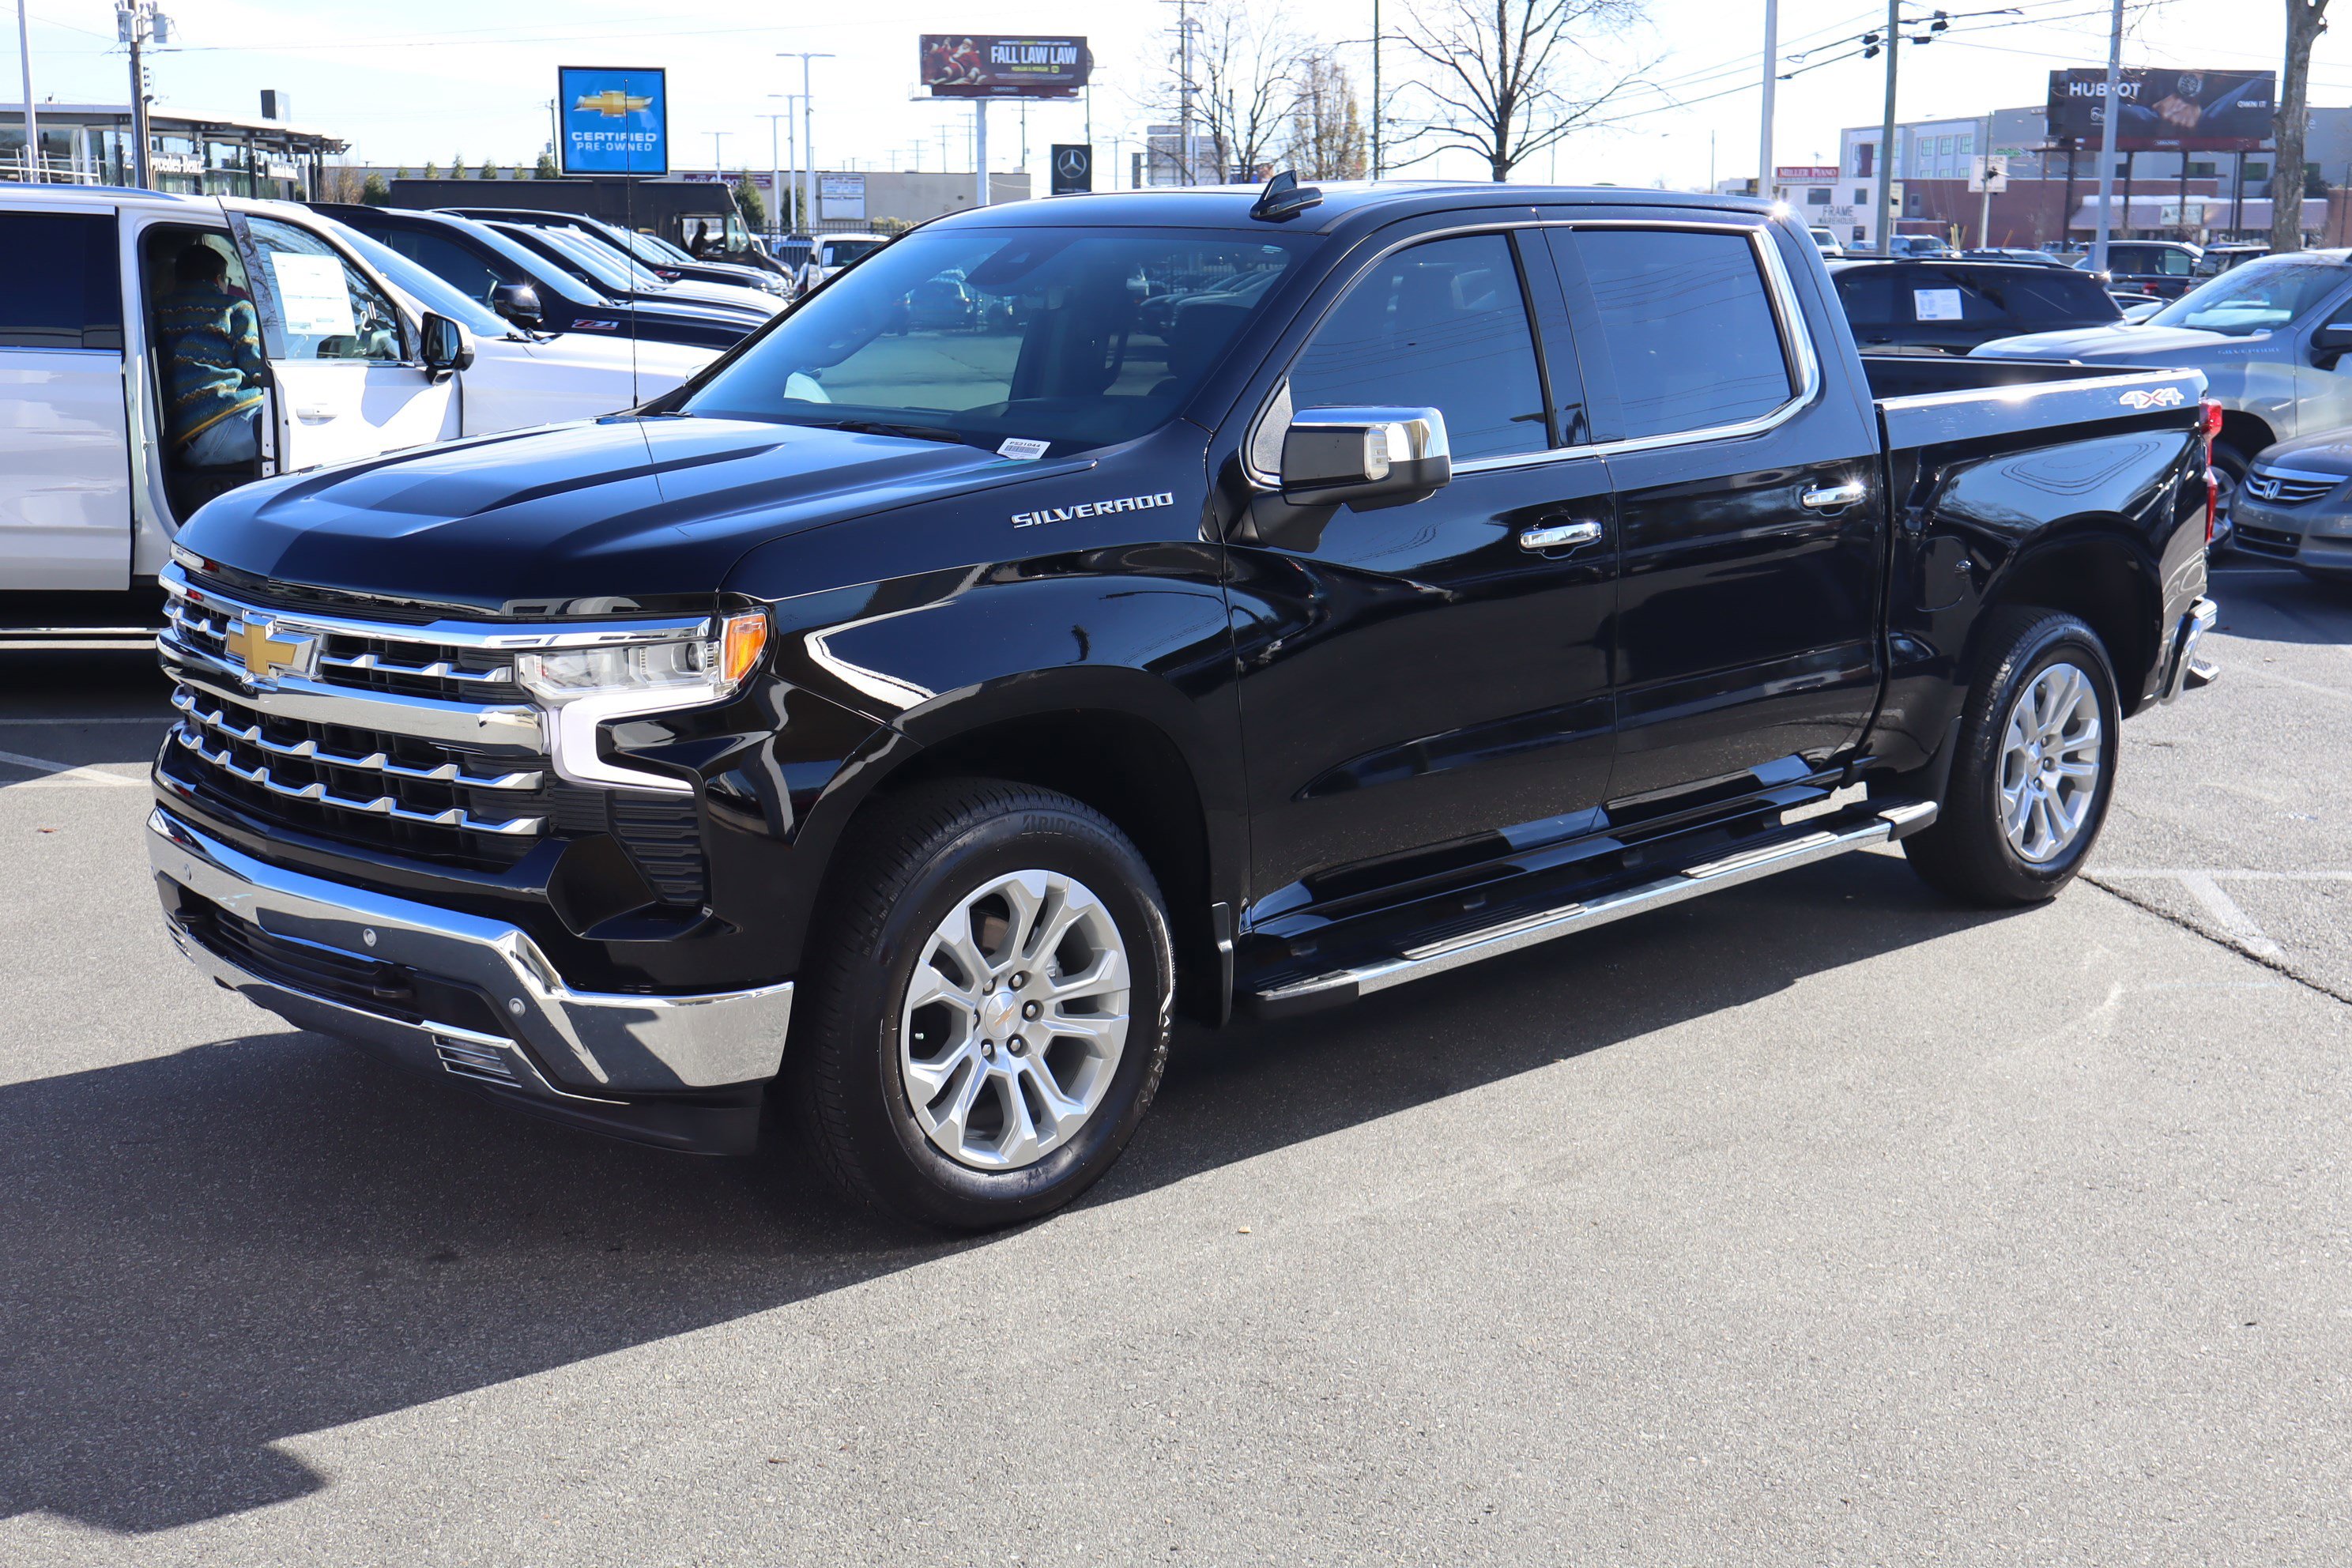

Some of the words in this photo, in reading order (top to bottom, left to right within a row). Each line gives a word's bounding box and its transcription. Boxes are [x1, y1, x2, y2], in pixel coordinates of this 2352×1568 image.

[990, 46, 1019, 64] FALL
[1021, 47, 1048, 64] LAW
[1050, 47, 1077, 65] LAW
[2069, 81, 2142, 97] HUBOT
[571, 132, 657, 142] CERTIFIED
[577, 142, 653, 151] PRE-OWNED
[150, 154, 202, 174] ercedes-Benz
[1778, 168, 1809, 178] MILLER
[1811, 168, 1838, 178] PIANO
[1822, 205, 1853, 216] FRAME
[1818, 217, 1858, 225] WAREHOUSE
[1010, 492, 1174, 529] SILVERADO
